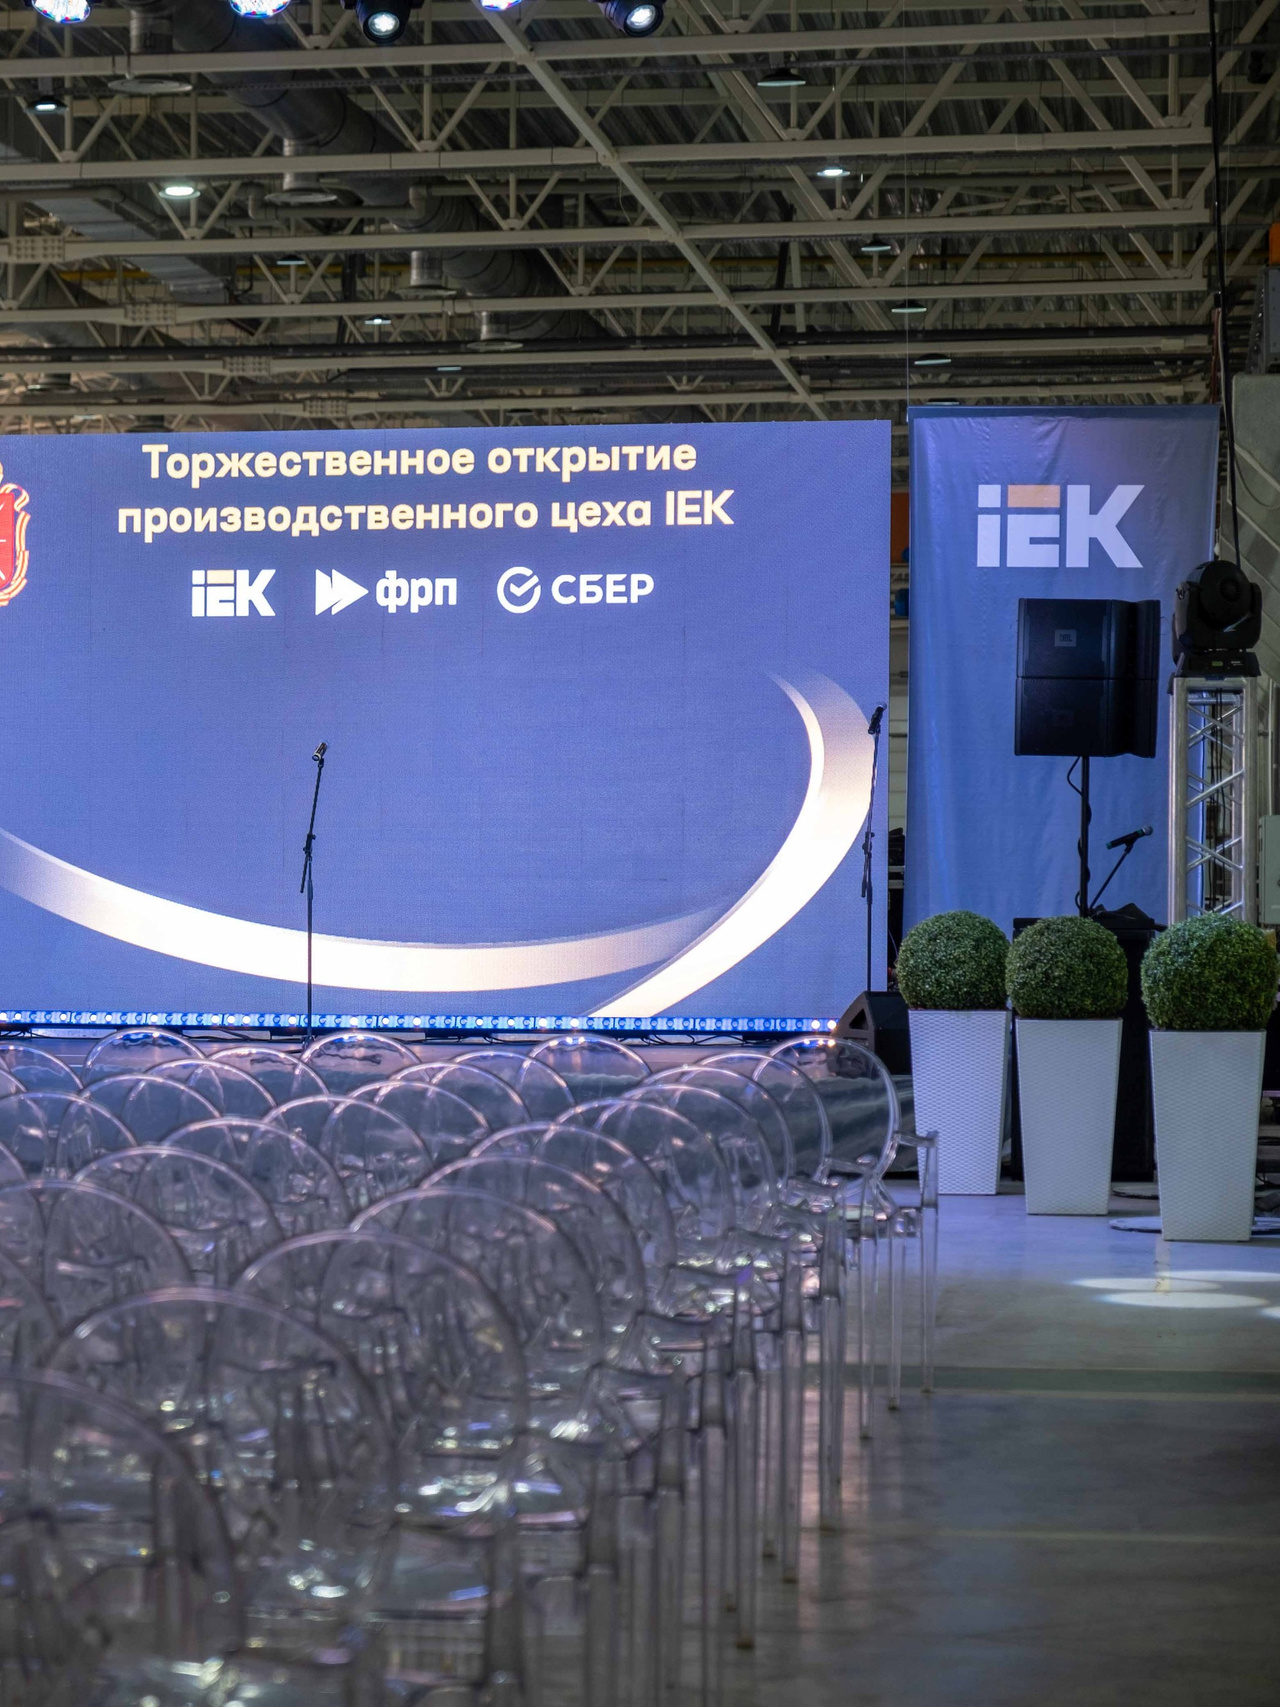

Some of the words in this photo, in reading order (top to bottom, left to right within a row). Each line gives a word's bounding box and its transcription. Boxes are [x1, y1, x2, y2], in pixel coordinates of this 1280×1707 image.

[141, 442, 475, 488] Торжественное
[487, 442, 697, 482] открытие
[118, 500, 539, 544] производственного
[551, 499, 652, 534] цеха
[665, 489, 735, 526] IEK
[376, 569, 458, 614] фрп
[551, 573, 655, 605] СБЕР
